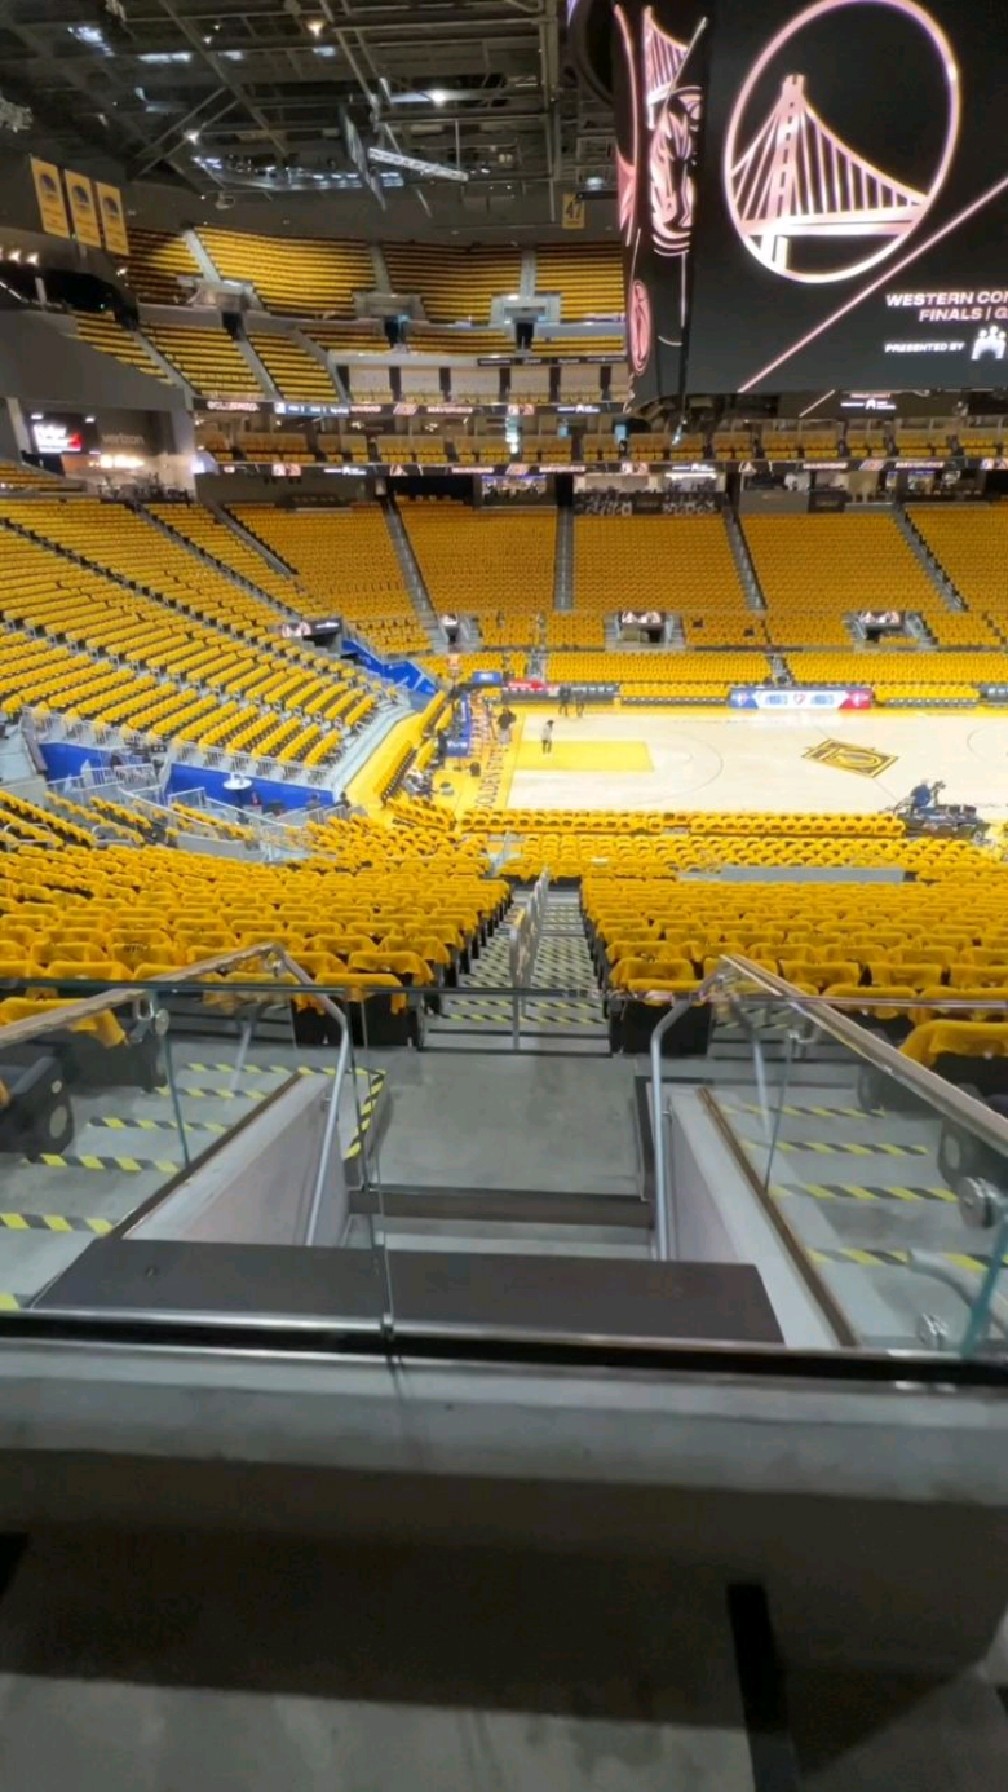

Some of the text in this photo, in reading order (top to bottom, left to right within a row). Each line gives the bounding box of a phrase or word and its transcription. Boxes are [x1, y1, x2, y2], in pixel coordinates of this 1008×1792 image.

[886, 291, 974, 306] WESTERN
[919, 306, 983, 322] FINALS
[884, 342, 965, 353] PRESENTED BY
